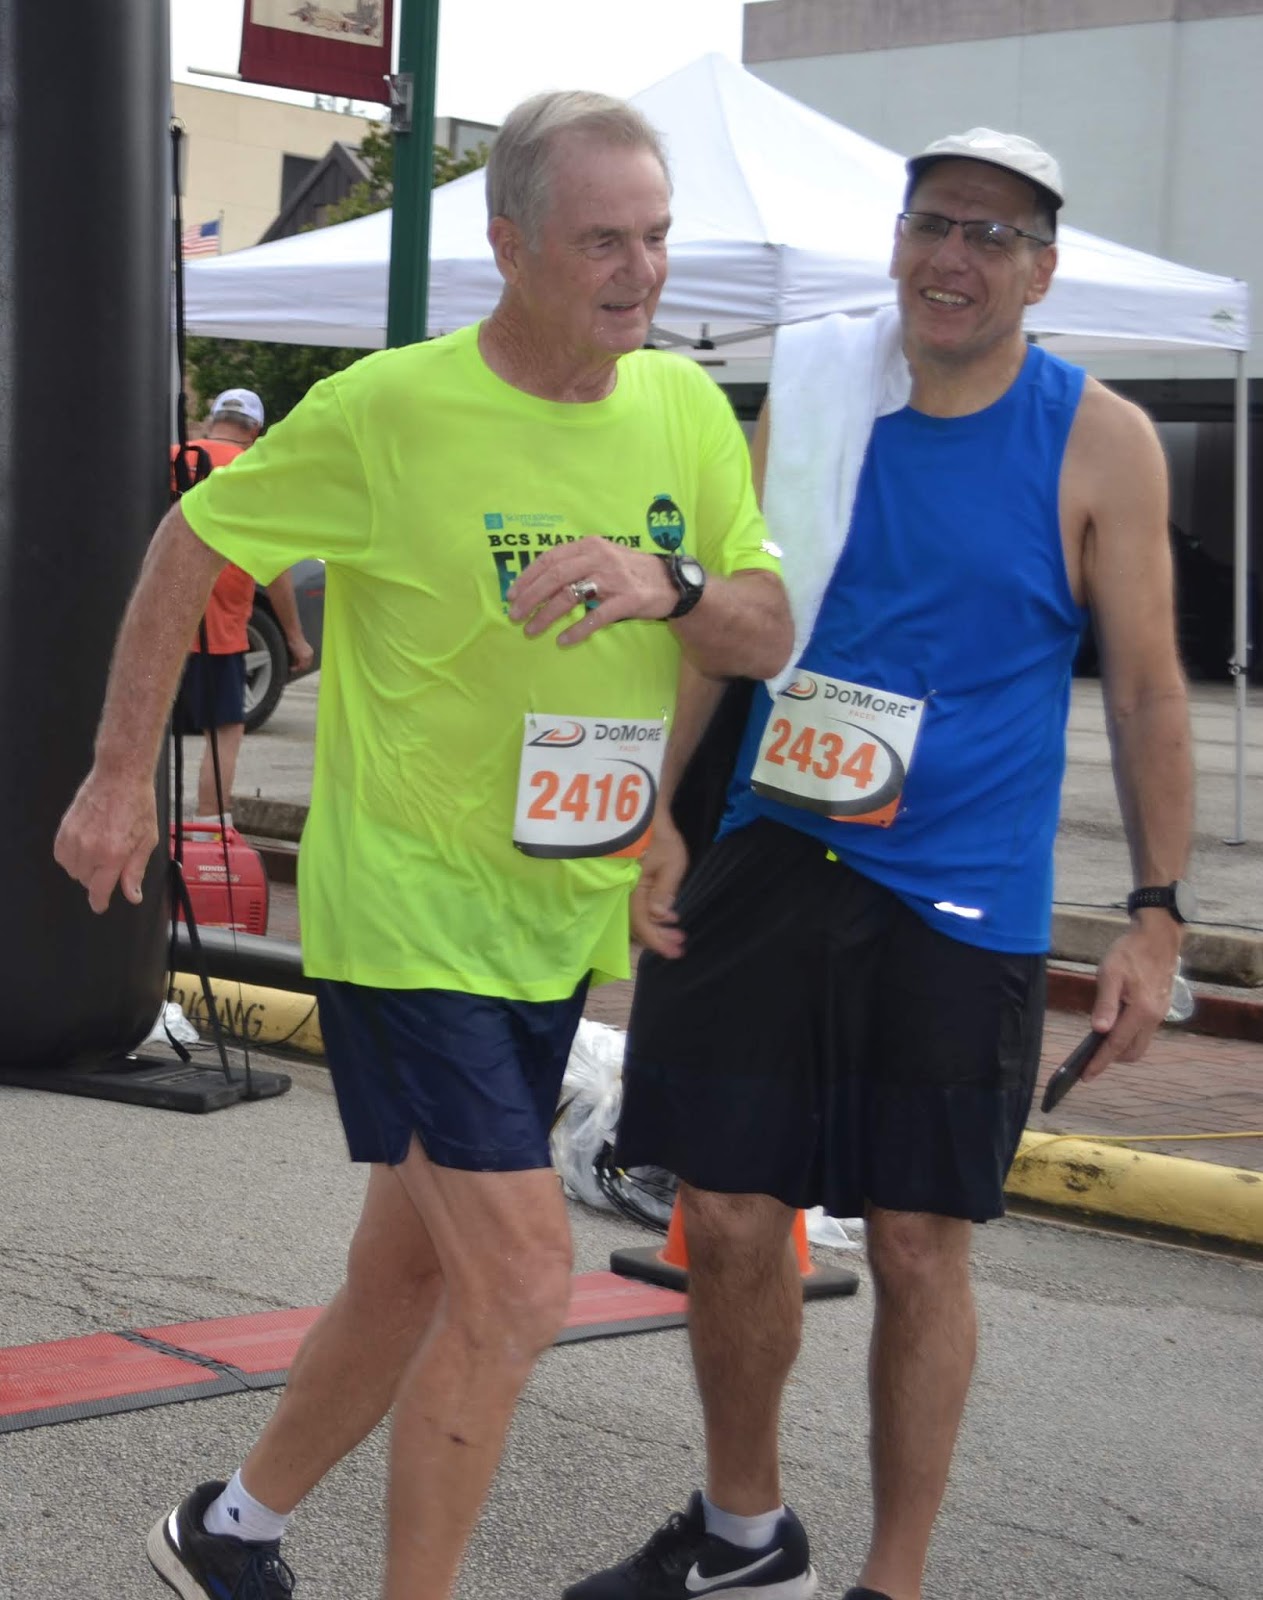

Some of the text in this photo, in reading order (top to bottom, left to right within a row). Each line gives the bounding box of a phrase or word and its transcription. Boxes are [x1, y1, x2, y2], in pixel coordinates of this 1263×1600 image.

[649, 510, 681, 528] 26.2
[488, 533, 531, 547] BCS
[764, 718, 878, 789] 2434
[527, 770, 642, 822] 2416
